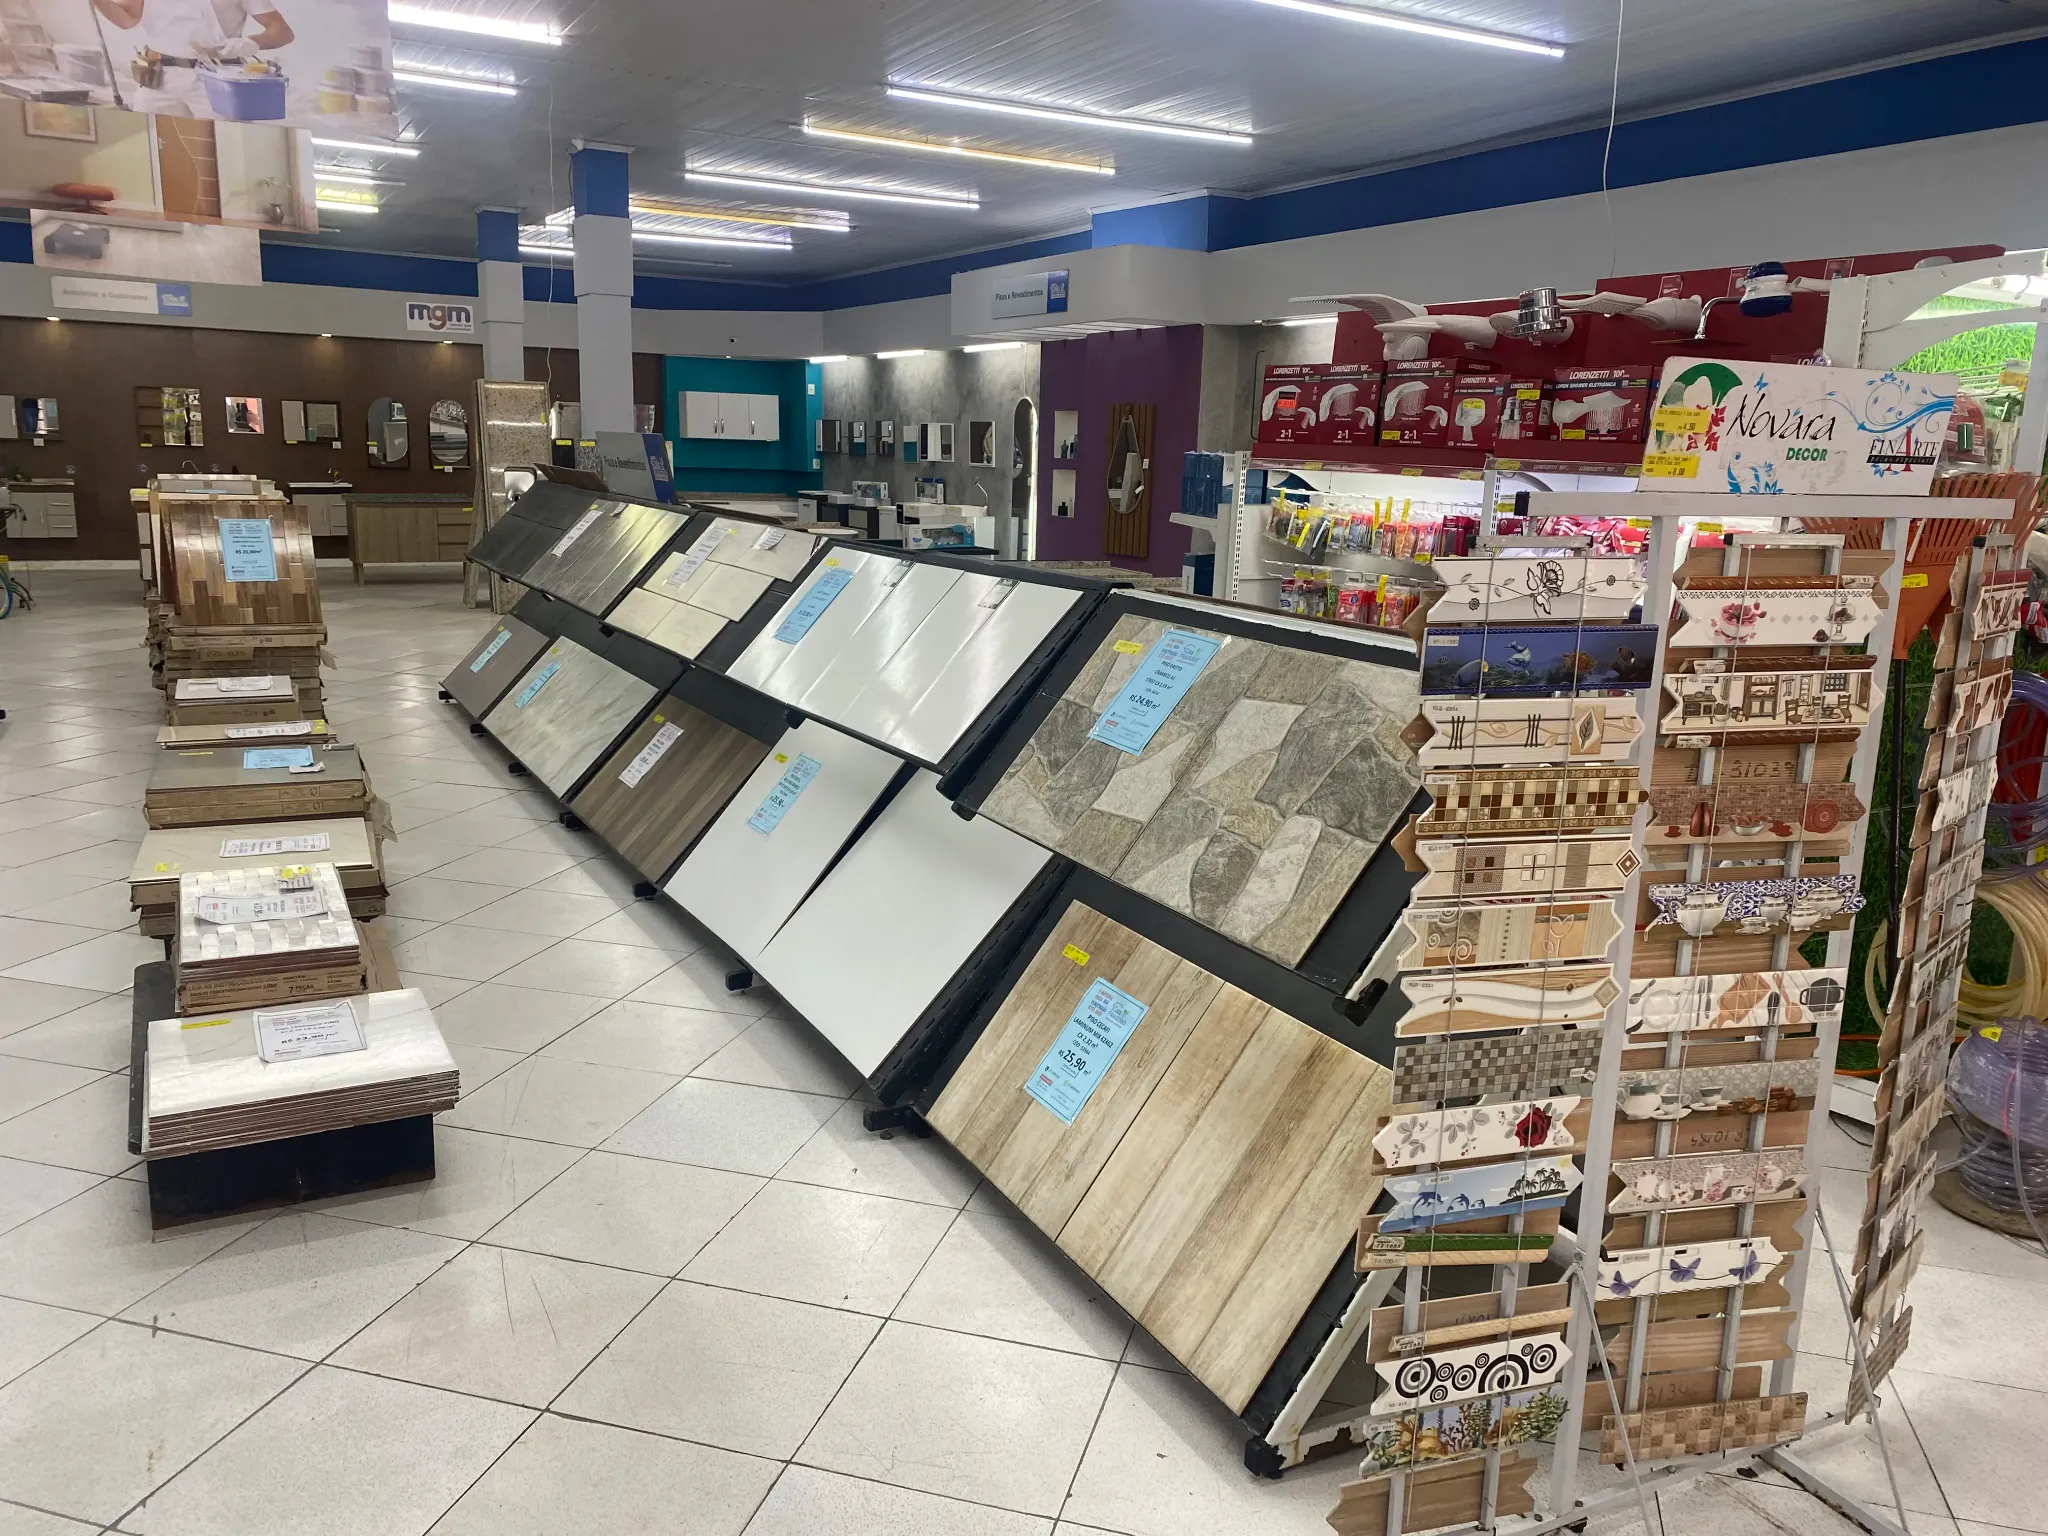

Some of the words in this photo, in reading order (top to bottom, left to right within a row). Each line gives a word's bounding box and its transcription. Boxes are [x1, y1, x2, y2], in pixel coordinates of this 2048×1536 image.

[996, 293, 1008, 301] Pisos
[1011, 289, 1044, 299] Revestimentos
[408, 304, 470, 330] mgm
[1273, 366, 1300, 375] LORENZETTI
[1330, 364, 1359, 373] LORENZETTI
[1396, 361, 1430, 370] LORENZETTI
[1569, 370, 1610, 380] LORENZETTI
[1786, 447, 1828, 462] DECOR
[1086, 1014, 1098, 1026] PISO
[1063, 1050, 1086, 1070] 25,90
